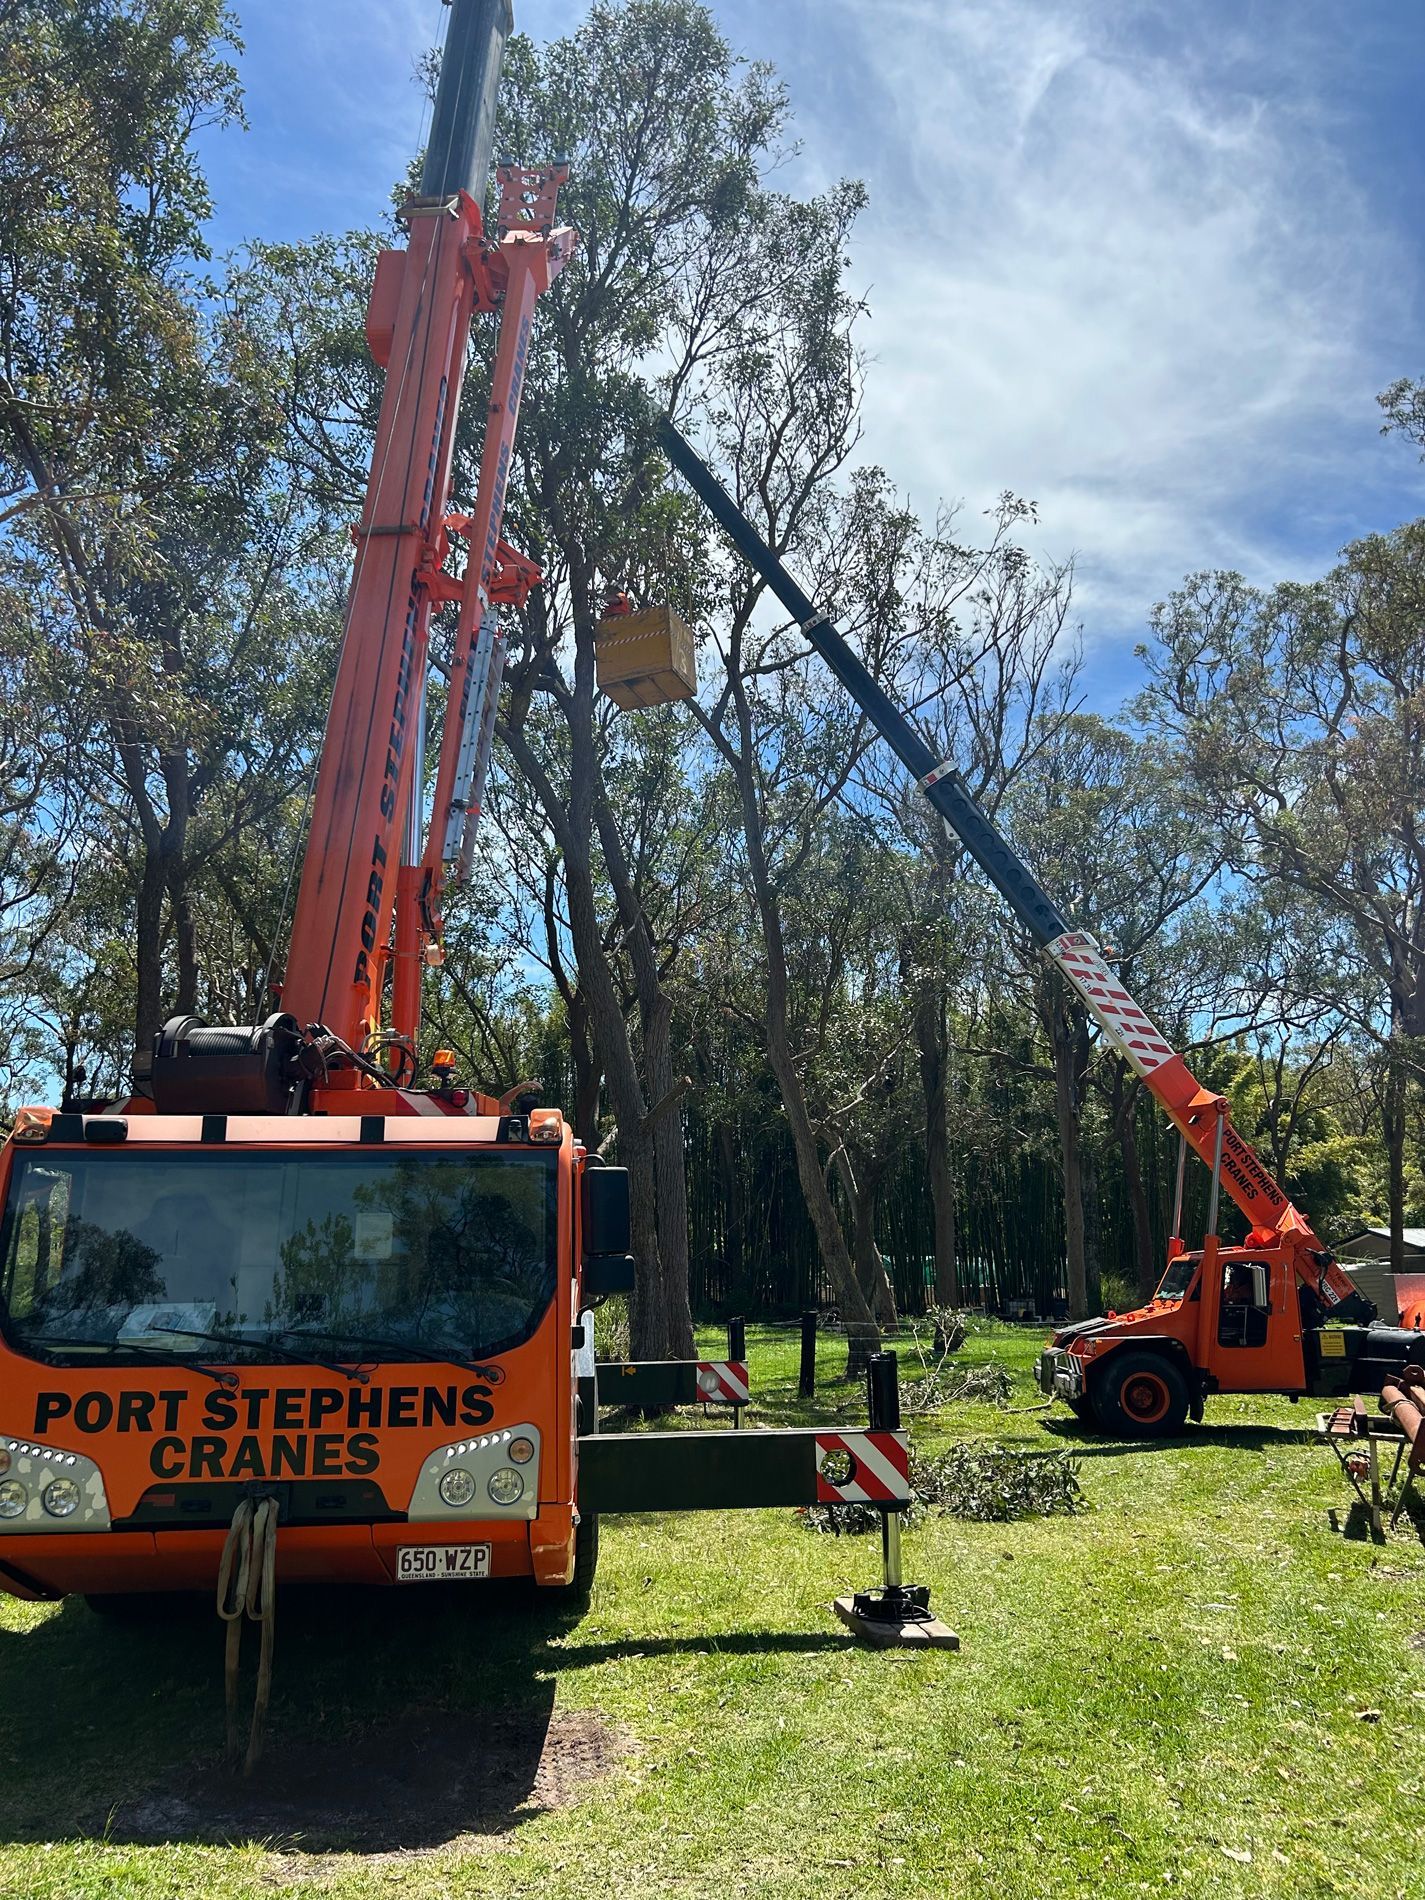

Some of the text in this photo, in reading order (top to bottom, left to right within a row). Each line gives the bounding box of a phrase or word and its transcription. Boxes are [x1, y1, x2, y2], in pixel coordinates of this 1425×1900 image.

[354, 834, 387, 988] PORT
[1221, 1152, 1258, 1200] CRANES
[1223, 1129, 1283, 1206] PORT STEPHENS
[34, 1385, 496, 1434] PORT STEPHENS
[149, 1433, 381, 1478] CRANES
